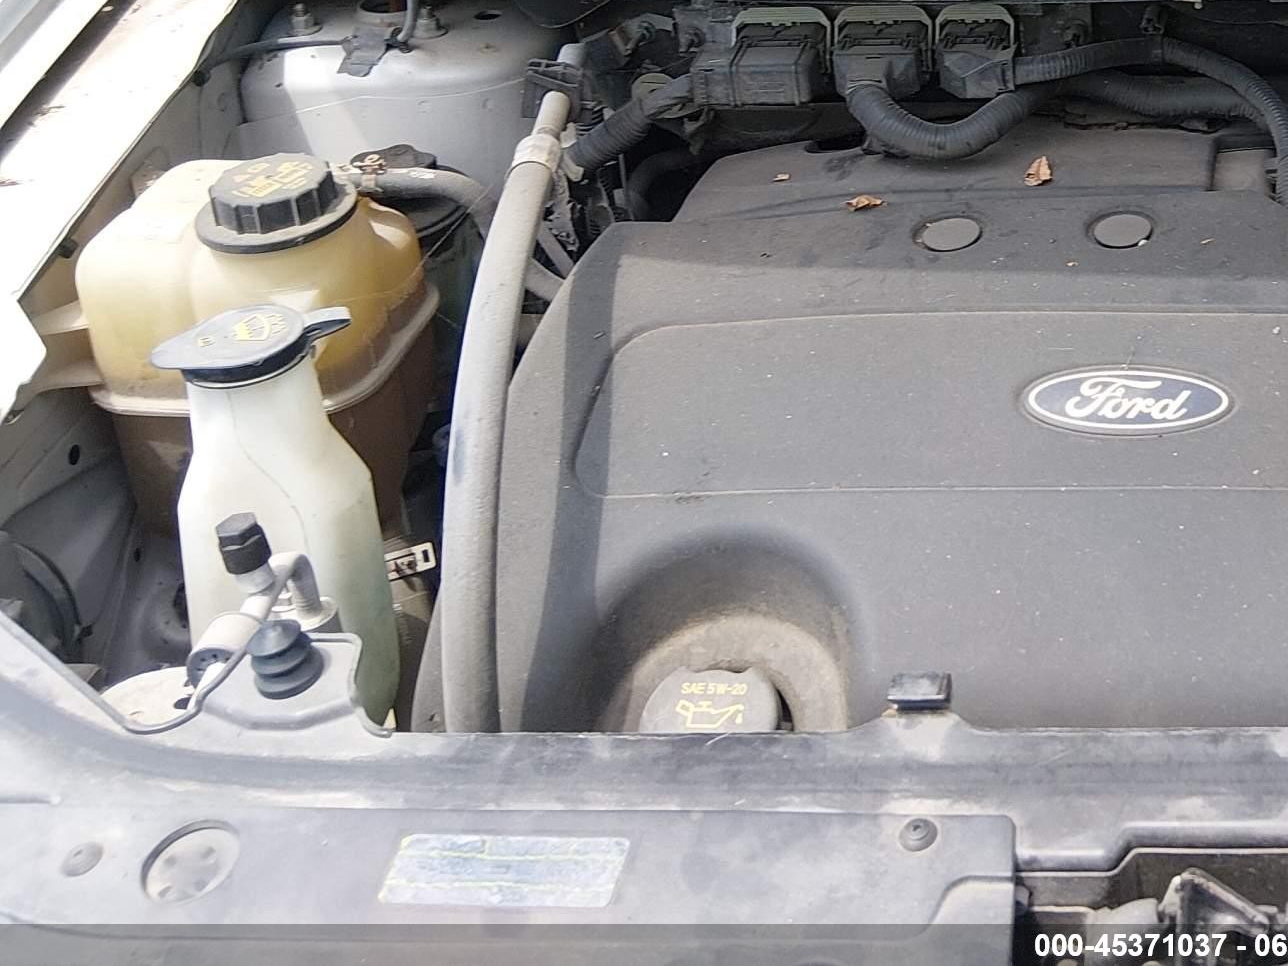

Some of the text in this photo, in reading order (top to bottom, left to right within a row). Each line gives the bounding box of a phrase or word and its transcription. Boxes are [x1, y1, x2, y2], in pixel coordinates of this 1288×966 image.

[1065, 377, 1192, 420] Ford
[681, 683, 747, 695] SAE 5W-20
